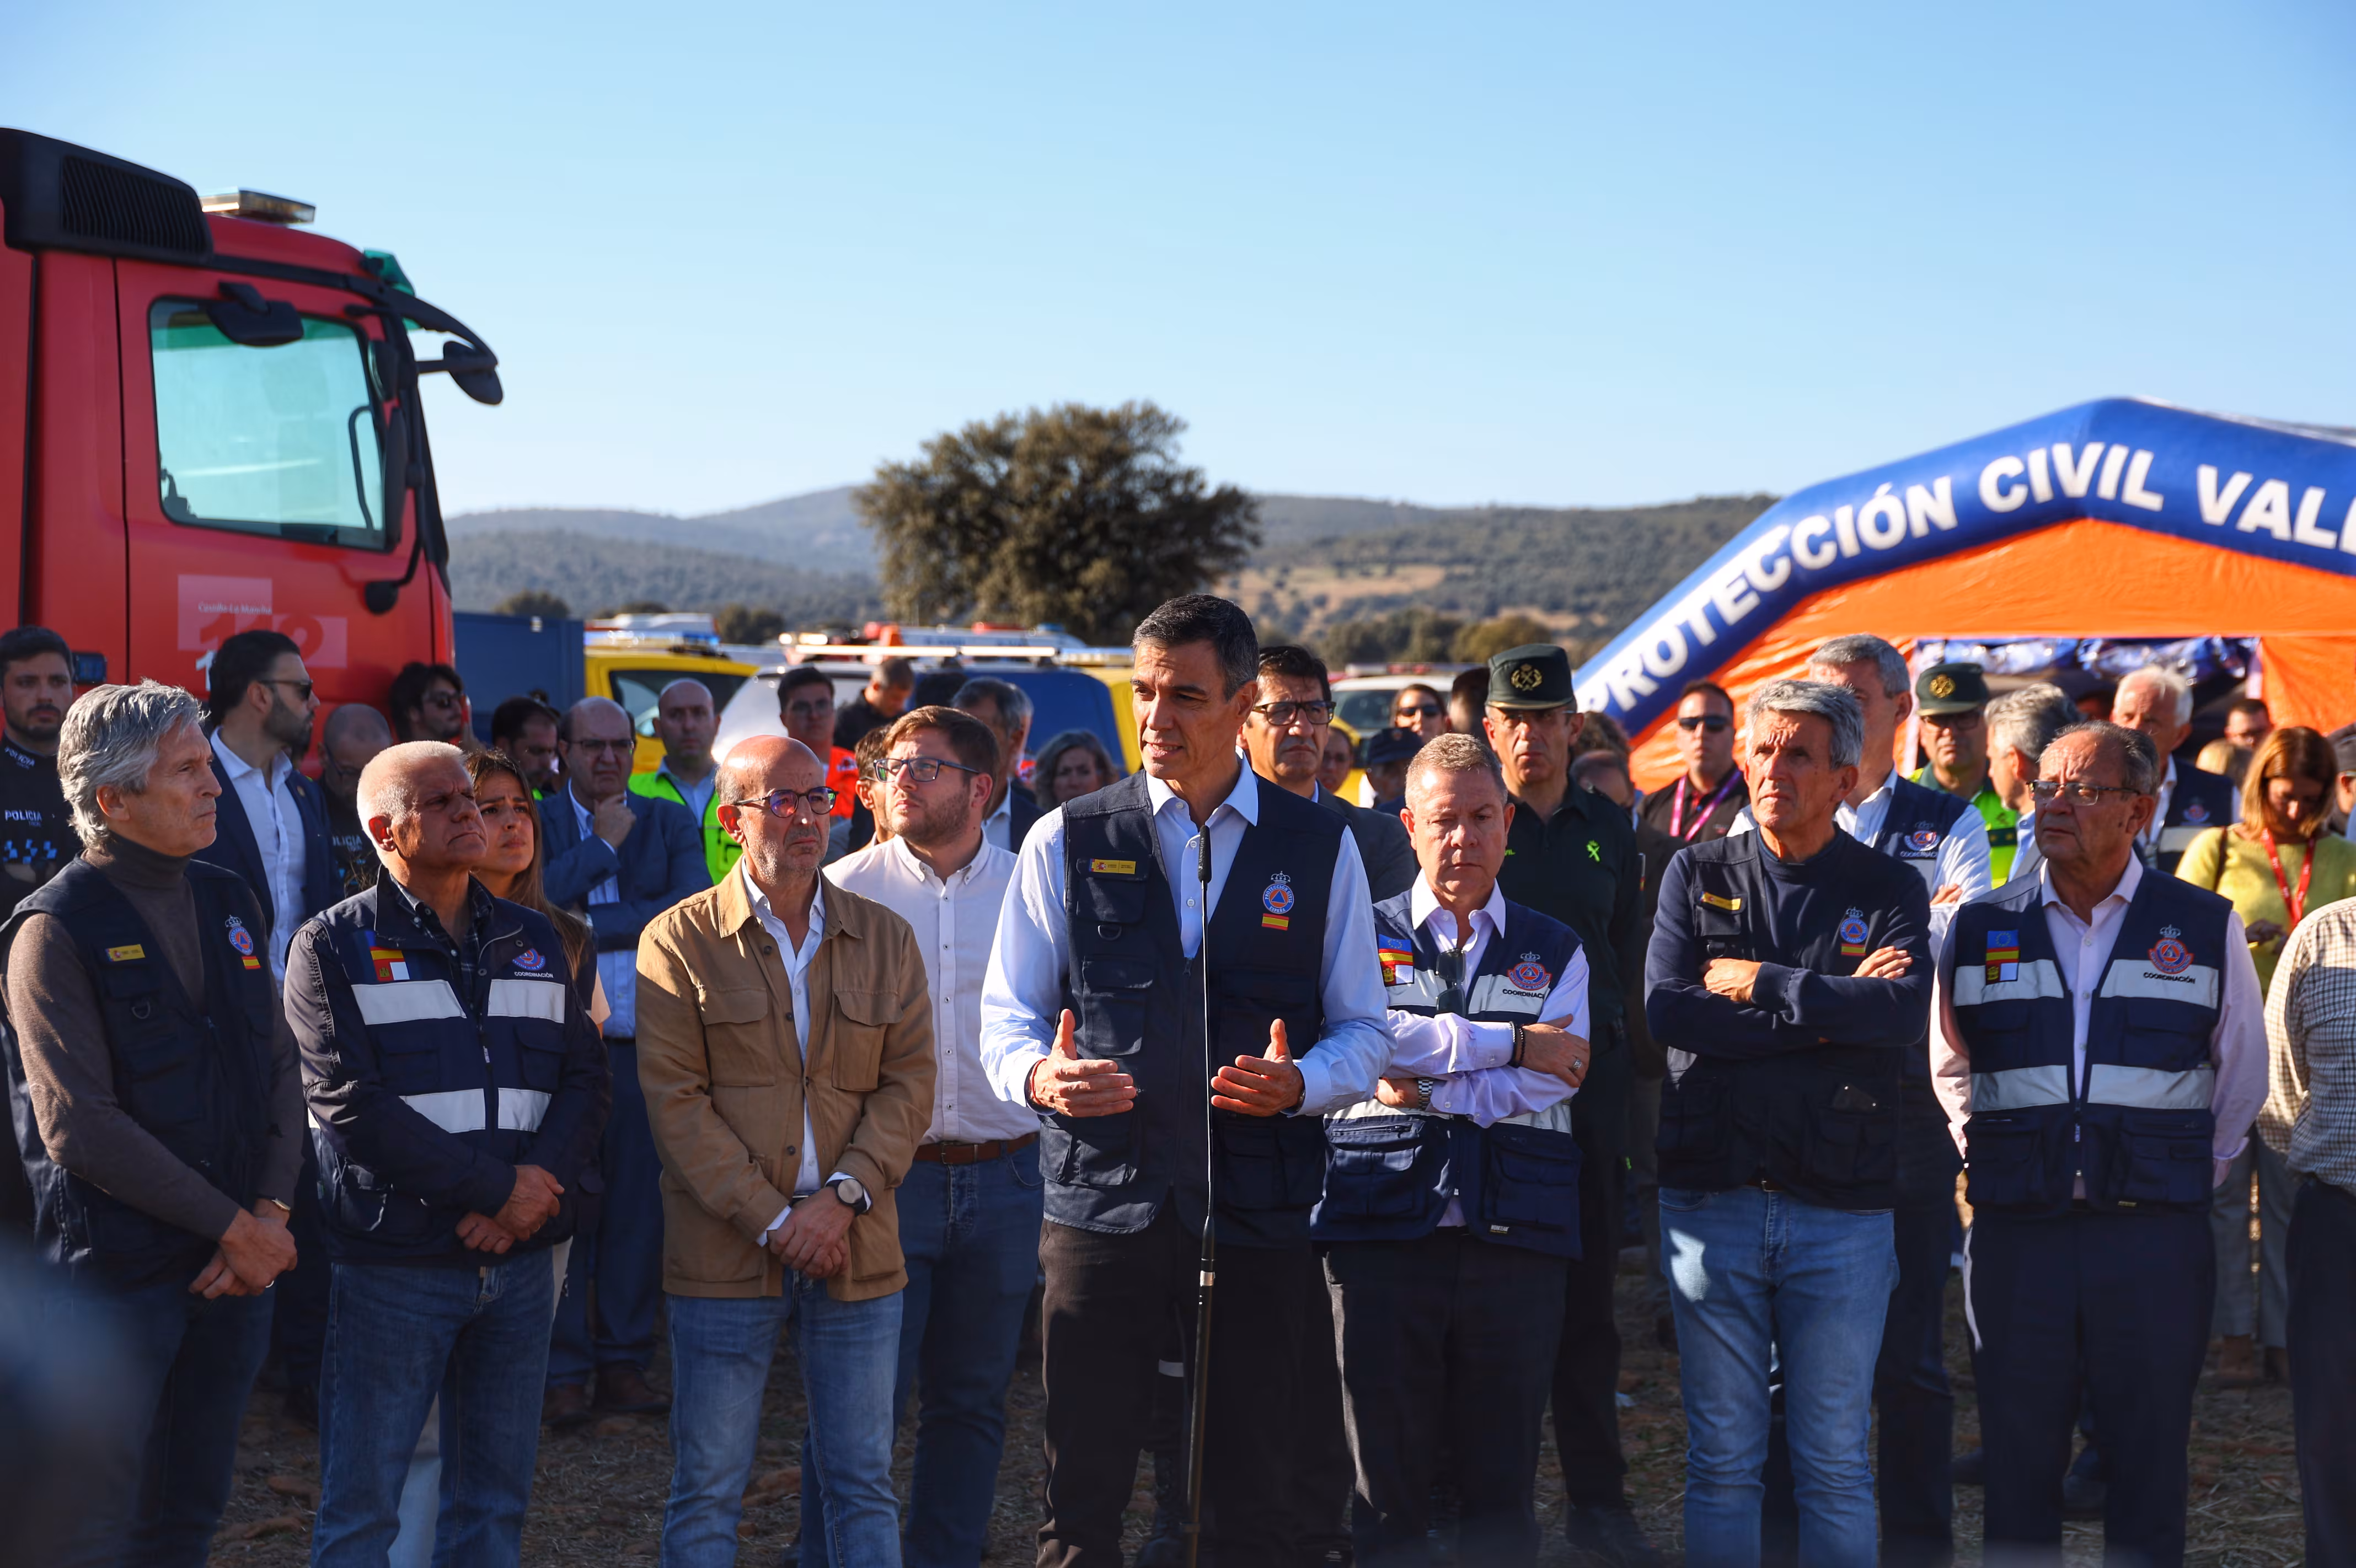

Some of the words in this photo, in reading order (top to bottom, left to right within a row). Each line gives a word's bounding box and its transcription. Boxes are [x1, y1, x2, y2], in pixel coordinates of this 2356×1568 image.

[1573, 475, 1957, 713] PROTECCIÓN
[1978, 442, 2163, 513] CIVIL
[4, 810, 42, 821] POLICIA
[2143, 971, 2196, 984] COORDINACIÓN
